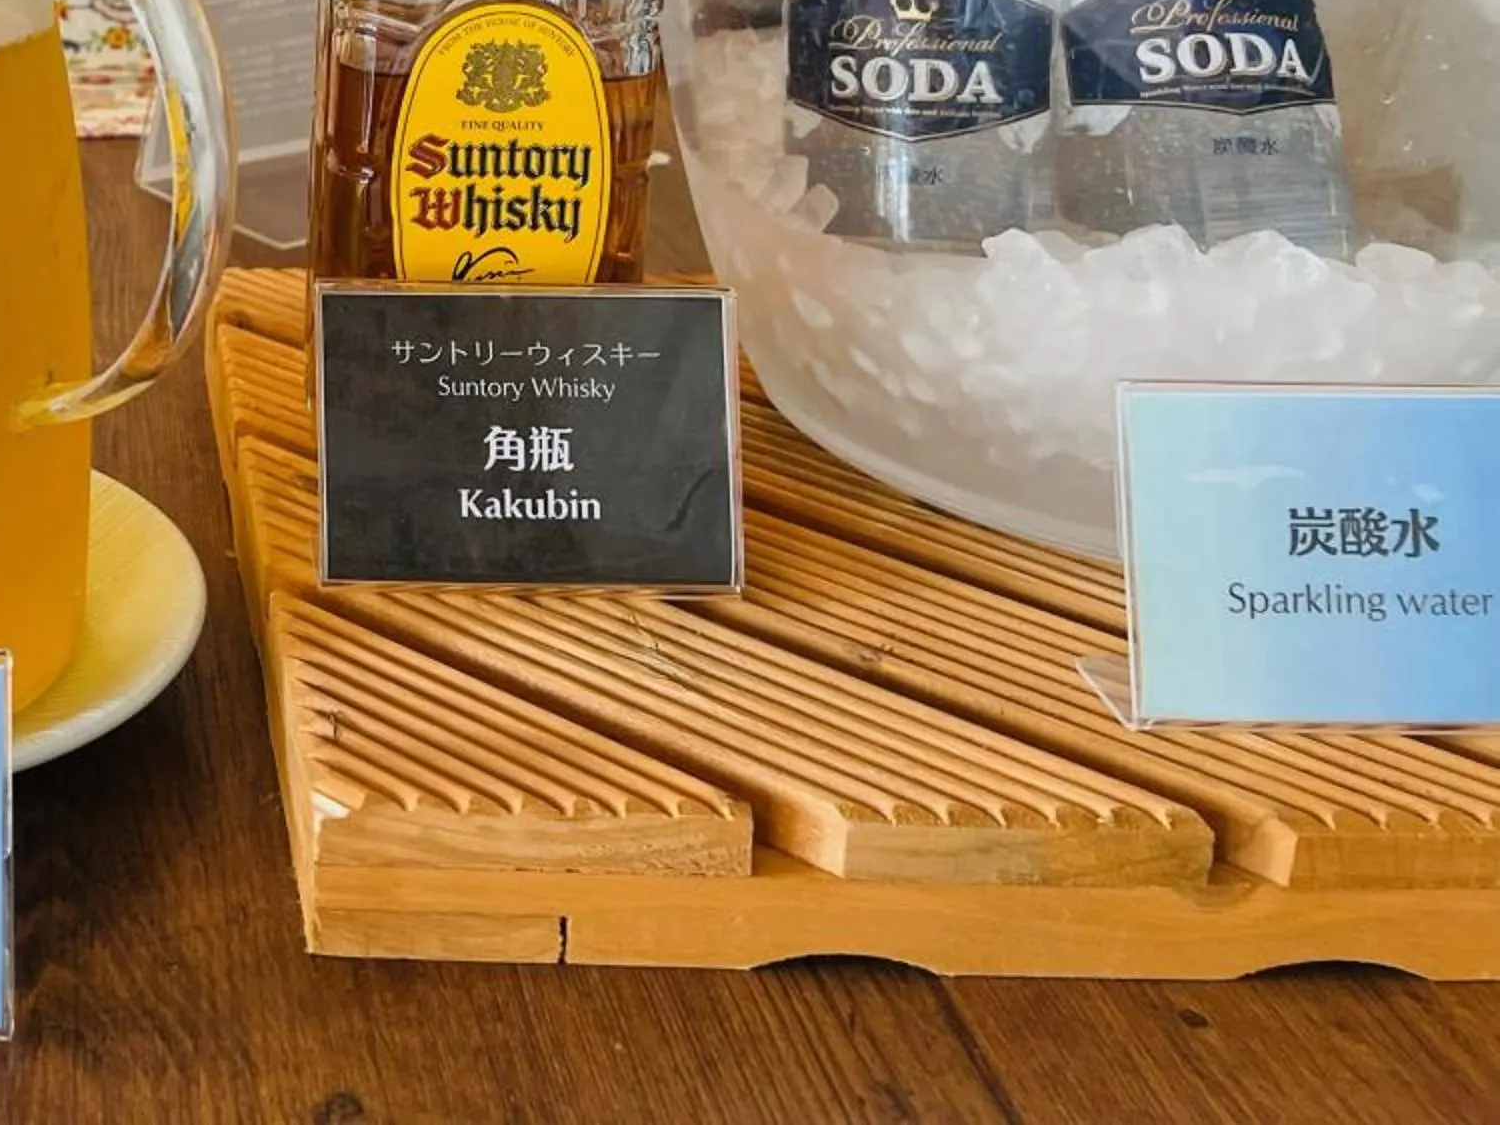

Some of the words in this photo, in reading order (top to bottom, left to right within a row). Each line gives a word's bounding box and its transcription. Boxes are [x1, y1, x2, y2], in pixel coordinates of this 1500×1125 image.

[828, 14, 1003, 56] Professional
[830, 55, 1004, 104] SODA
[1136, 32, 1315, 84] SODA
[460, 119, 487, 131] FINE
[491, 120, 545, 132] QUALITY
[405, 133, 591, 186] Suntory
[409, 183, 581, 242] Whisky
[392, 340, 661, 367] サントリーウィスキー
[438, 376, 524, 402] Suntory
[531, 377, 616, 402] Whisky
[483, 426, 575, 472] 角瓶
[459, 489, 601, 520] Kakubin
[1288, 507, 1441, 557] 炭酸水
[1228, 583, 1387, 622] Sparkling
[1396, 591, 1492, 616] water
